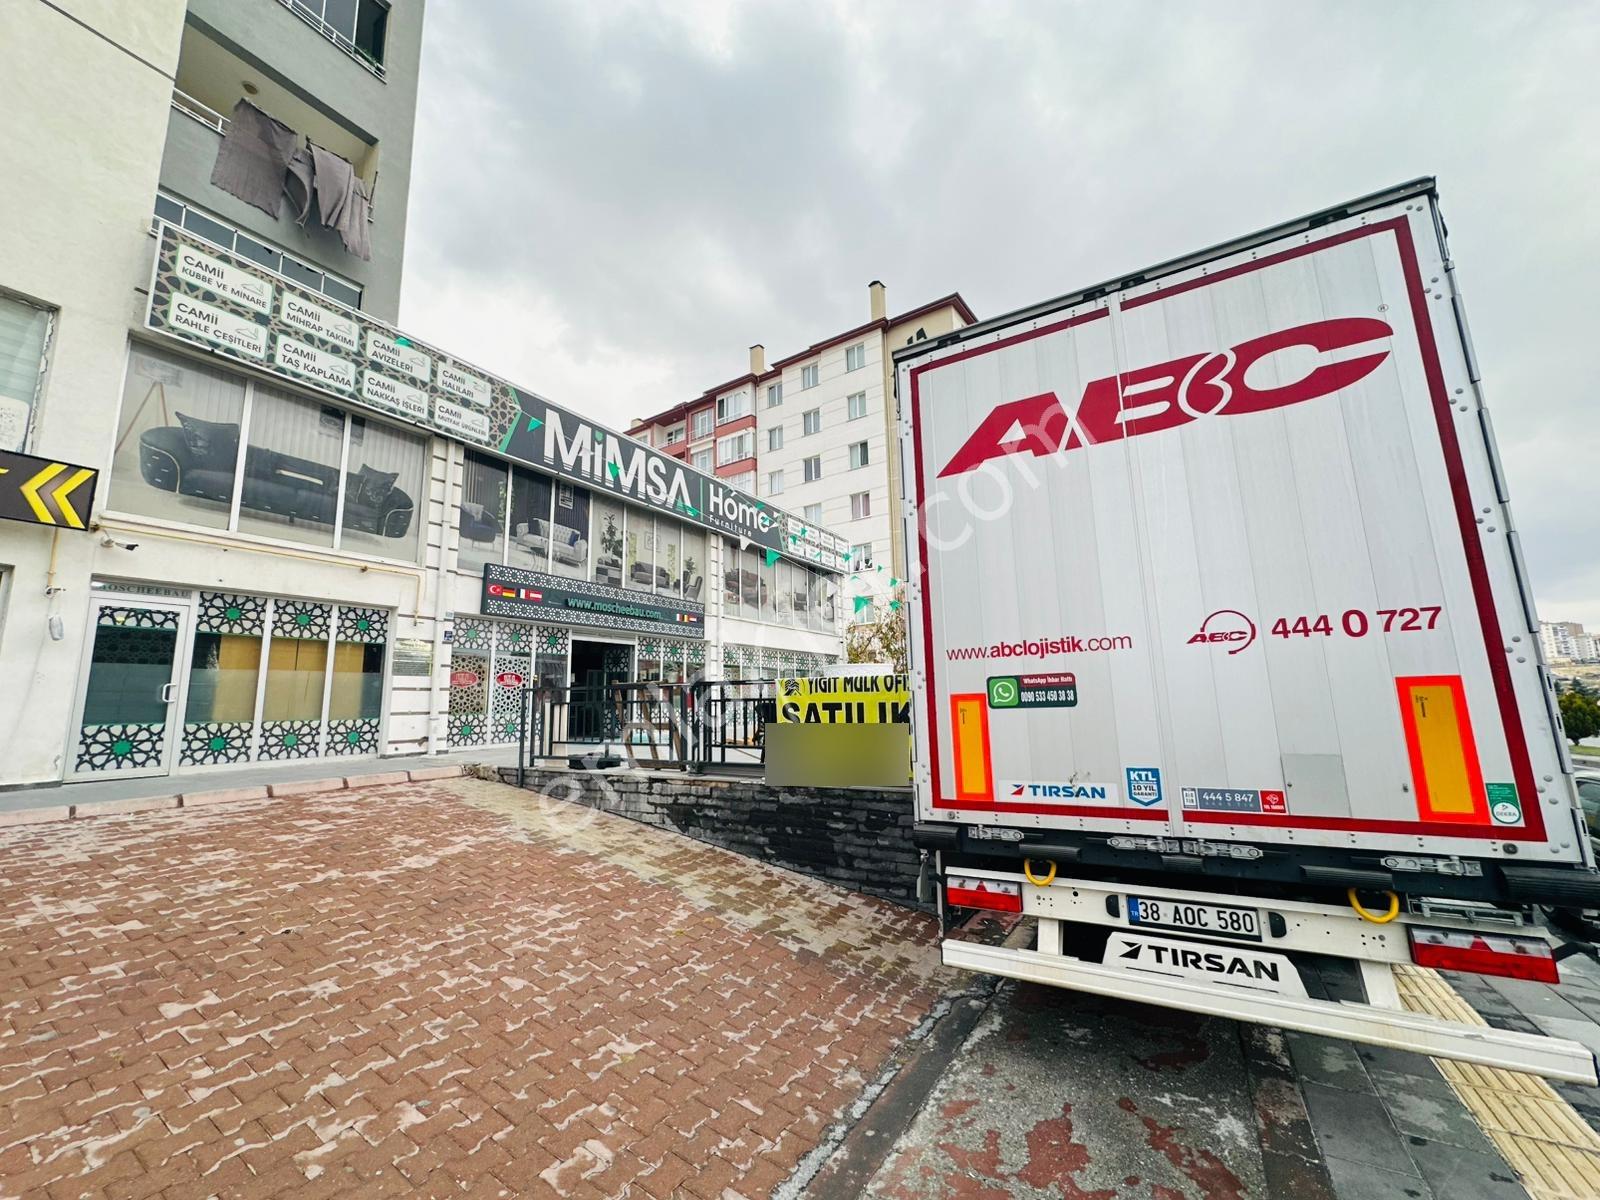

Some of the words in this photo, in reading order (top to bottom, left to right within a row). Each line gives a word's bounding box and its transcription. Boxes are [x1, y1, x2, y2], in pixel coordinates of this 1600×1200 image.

[181, 266, 214, 286] KUBBE
[215, 280, 229, 292] VE
[175, 314, 211, 334] RAHLE
[302, 363, 352, 388] KAPLAMA
[936, 316, 1395, 479] ABC
[1271, 614, 1333, 639] 444
[1376, 606, 1442, 633] 727
[946, 633, 1133, 661] www.abclojistik.com
[1020, 690, 1036, 703] 0090
[1035, 690, 1047, 702] 533
[1129, 770, 1157, 781] KTL
[1132, 784, 1143, 792] 10
[1028, 783, 1106, 799] TIRSAN
[1202, 791, 1223, 801] 444
[1224, 792, 1232, 802] 5
[1234, 793, 1255, 803] 847
[1139, 901, 1161, 922] 38
[1172, 908, 1209, 928] AOC
[1217, 911, 1254, 934] 580
[1147, 944, 1280, 982] TIRSAN
